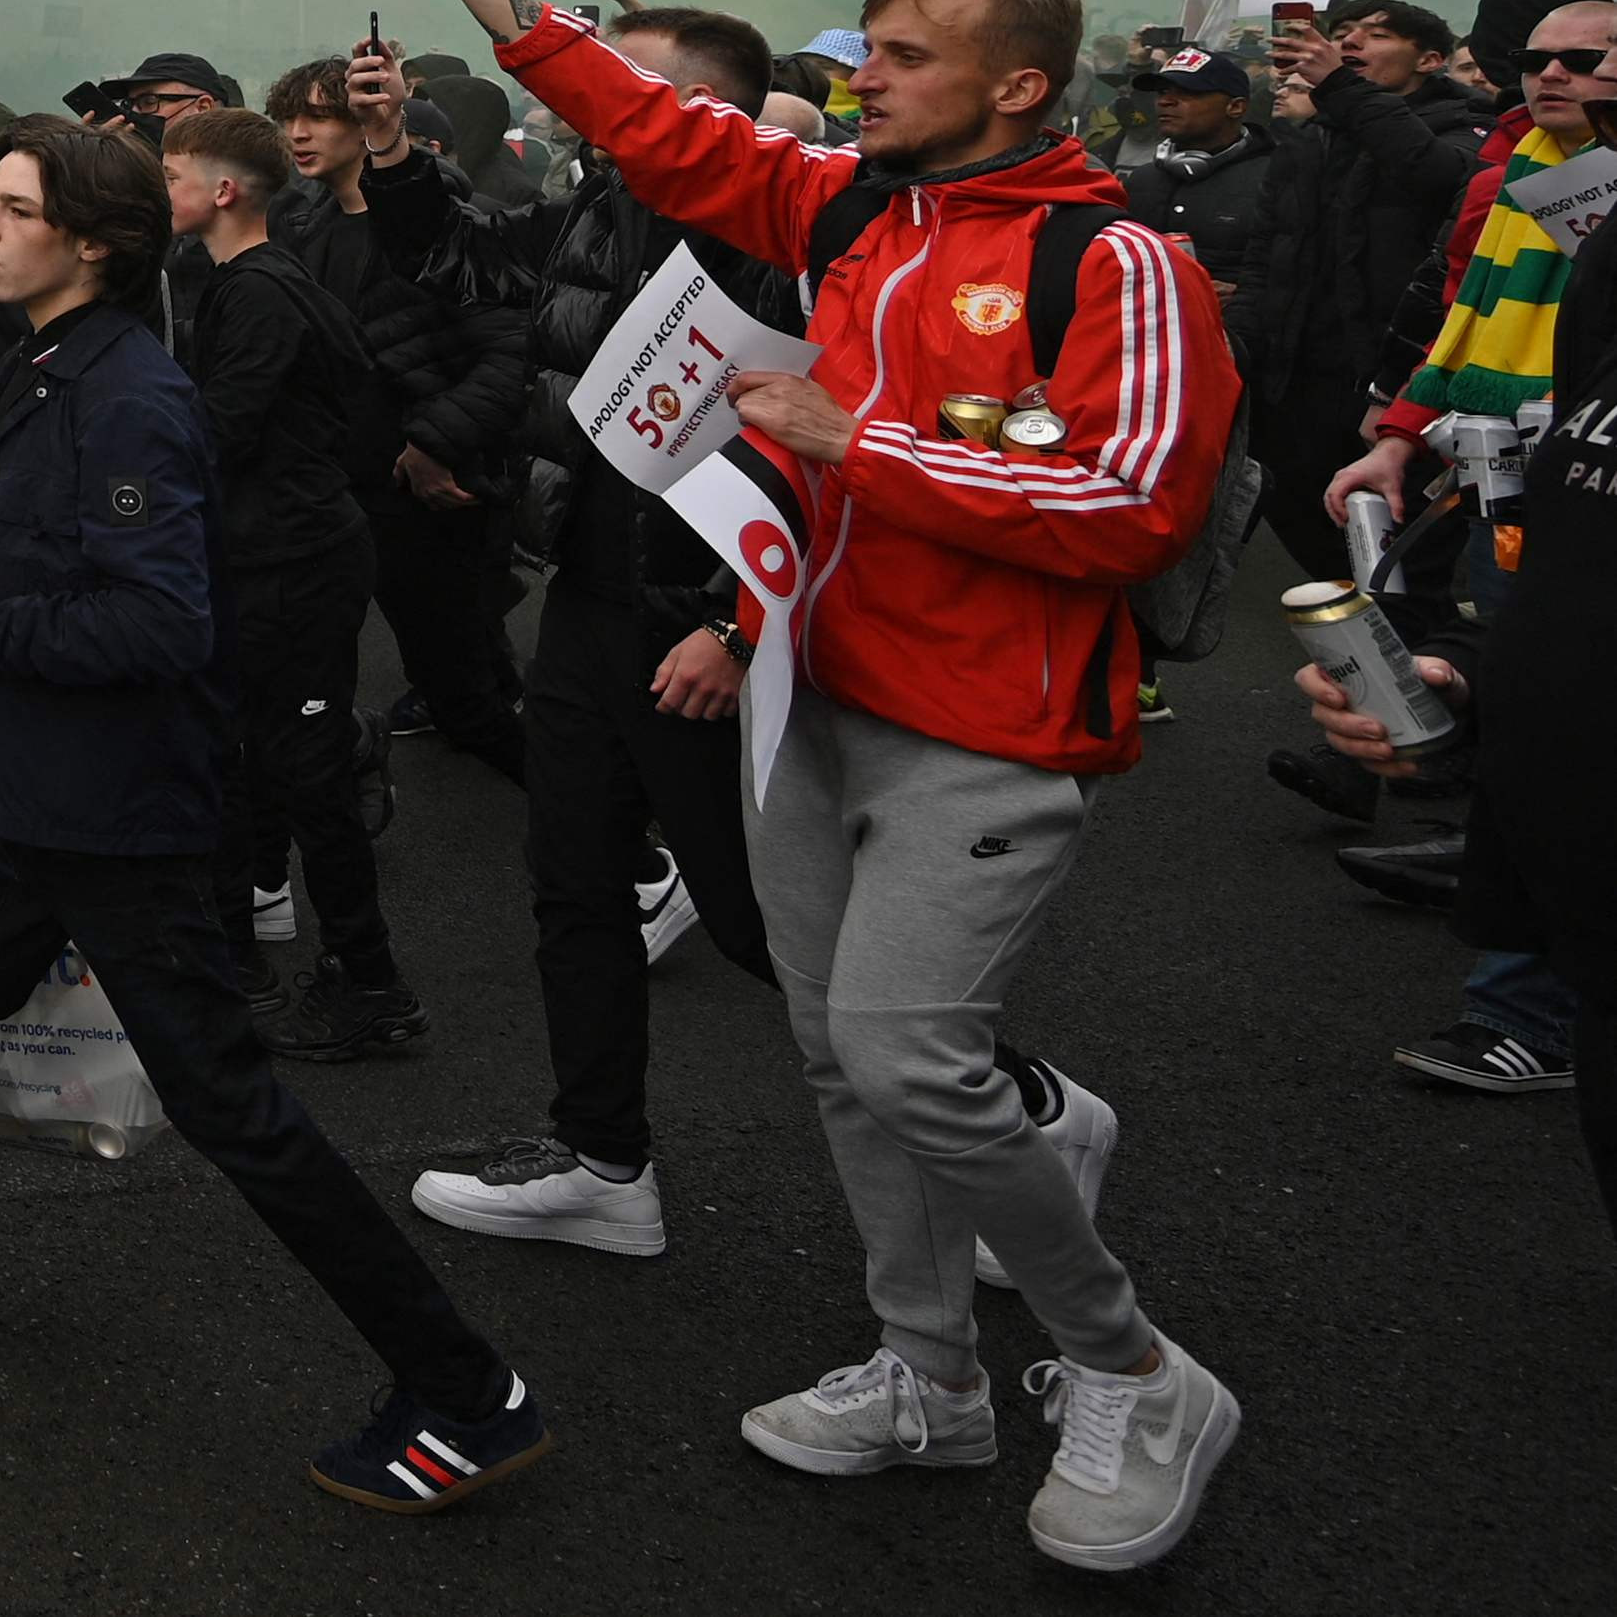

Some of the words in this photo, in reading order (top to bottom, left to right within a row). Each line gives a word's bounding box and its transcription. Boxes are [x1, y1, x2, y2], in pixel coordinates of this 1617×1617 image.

[1530, 196, 1575, 221] APOLOGY
[1574, 186, 1603, 205] NOT
[589, 373, 636, 440] APOLOGY
[631, 342, 658, 379] NOT
[654, 275, 706, 349] ACCEPTED
[667, 362, 741, 458] #PROTECTTHELEGACY
[978, 835, 1012, 851] NIKE
[21, 1023, 55, 1038] 100%
[57, 1026, 113, 1042] recycled
[7, 1041, 20, 1052] as
[22, 1042, 45, 1055] you
[47, 1045, 76, 1056] can.
